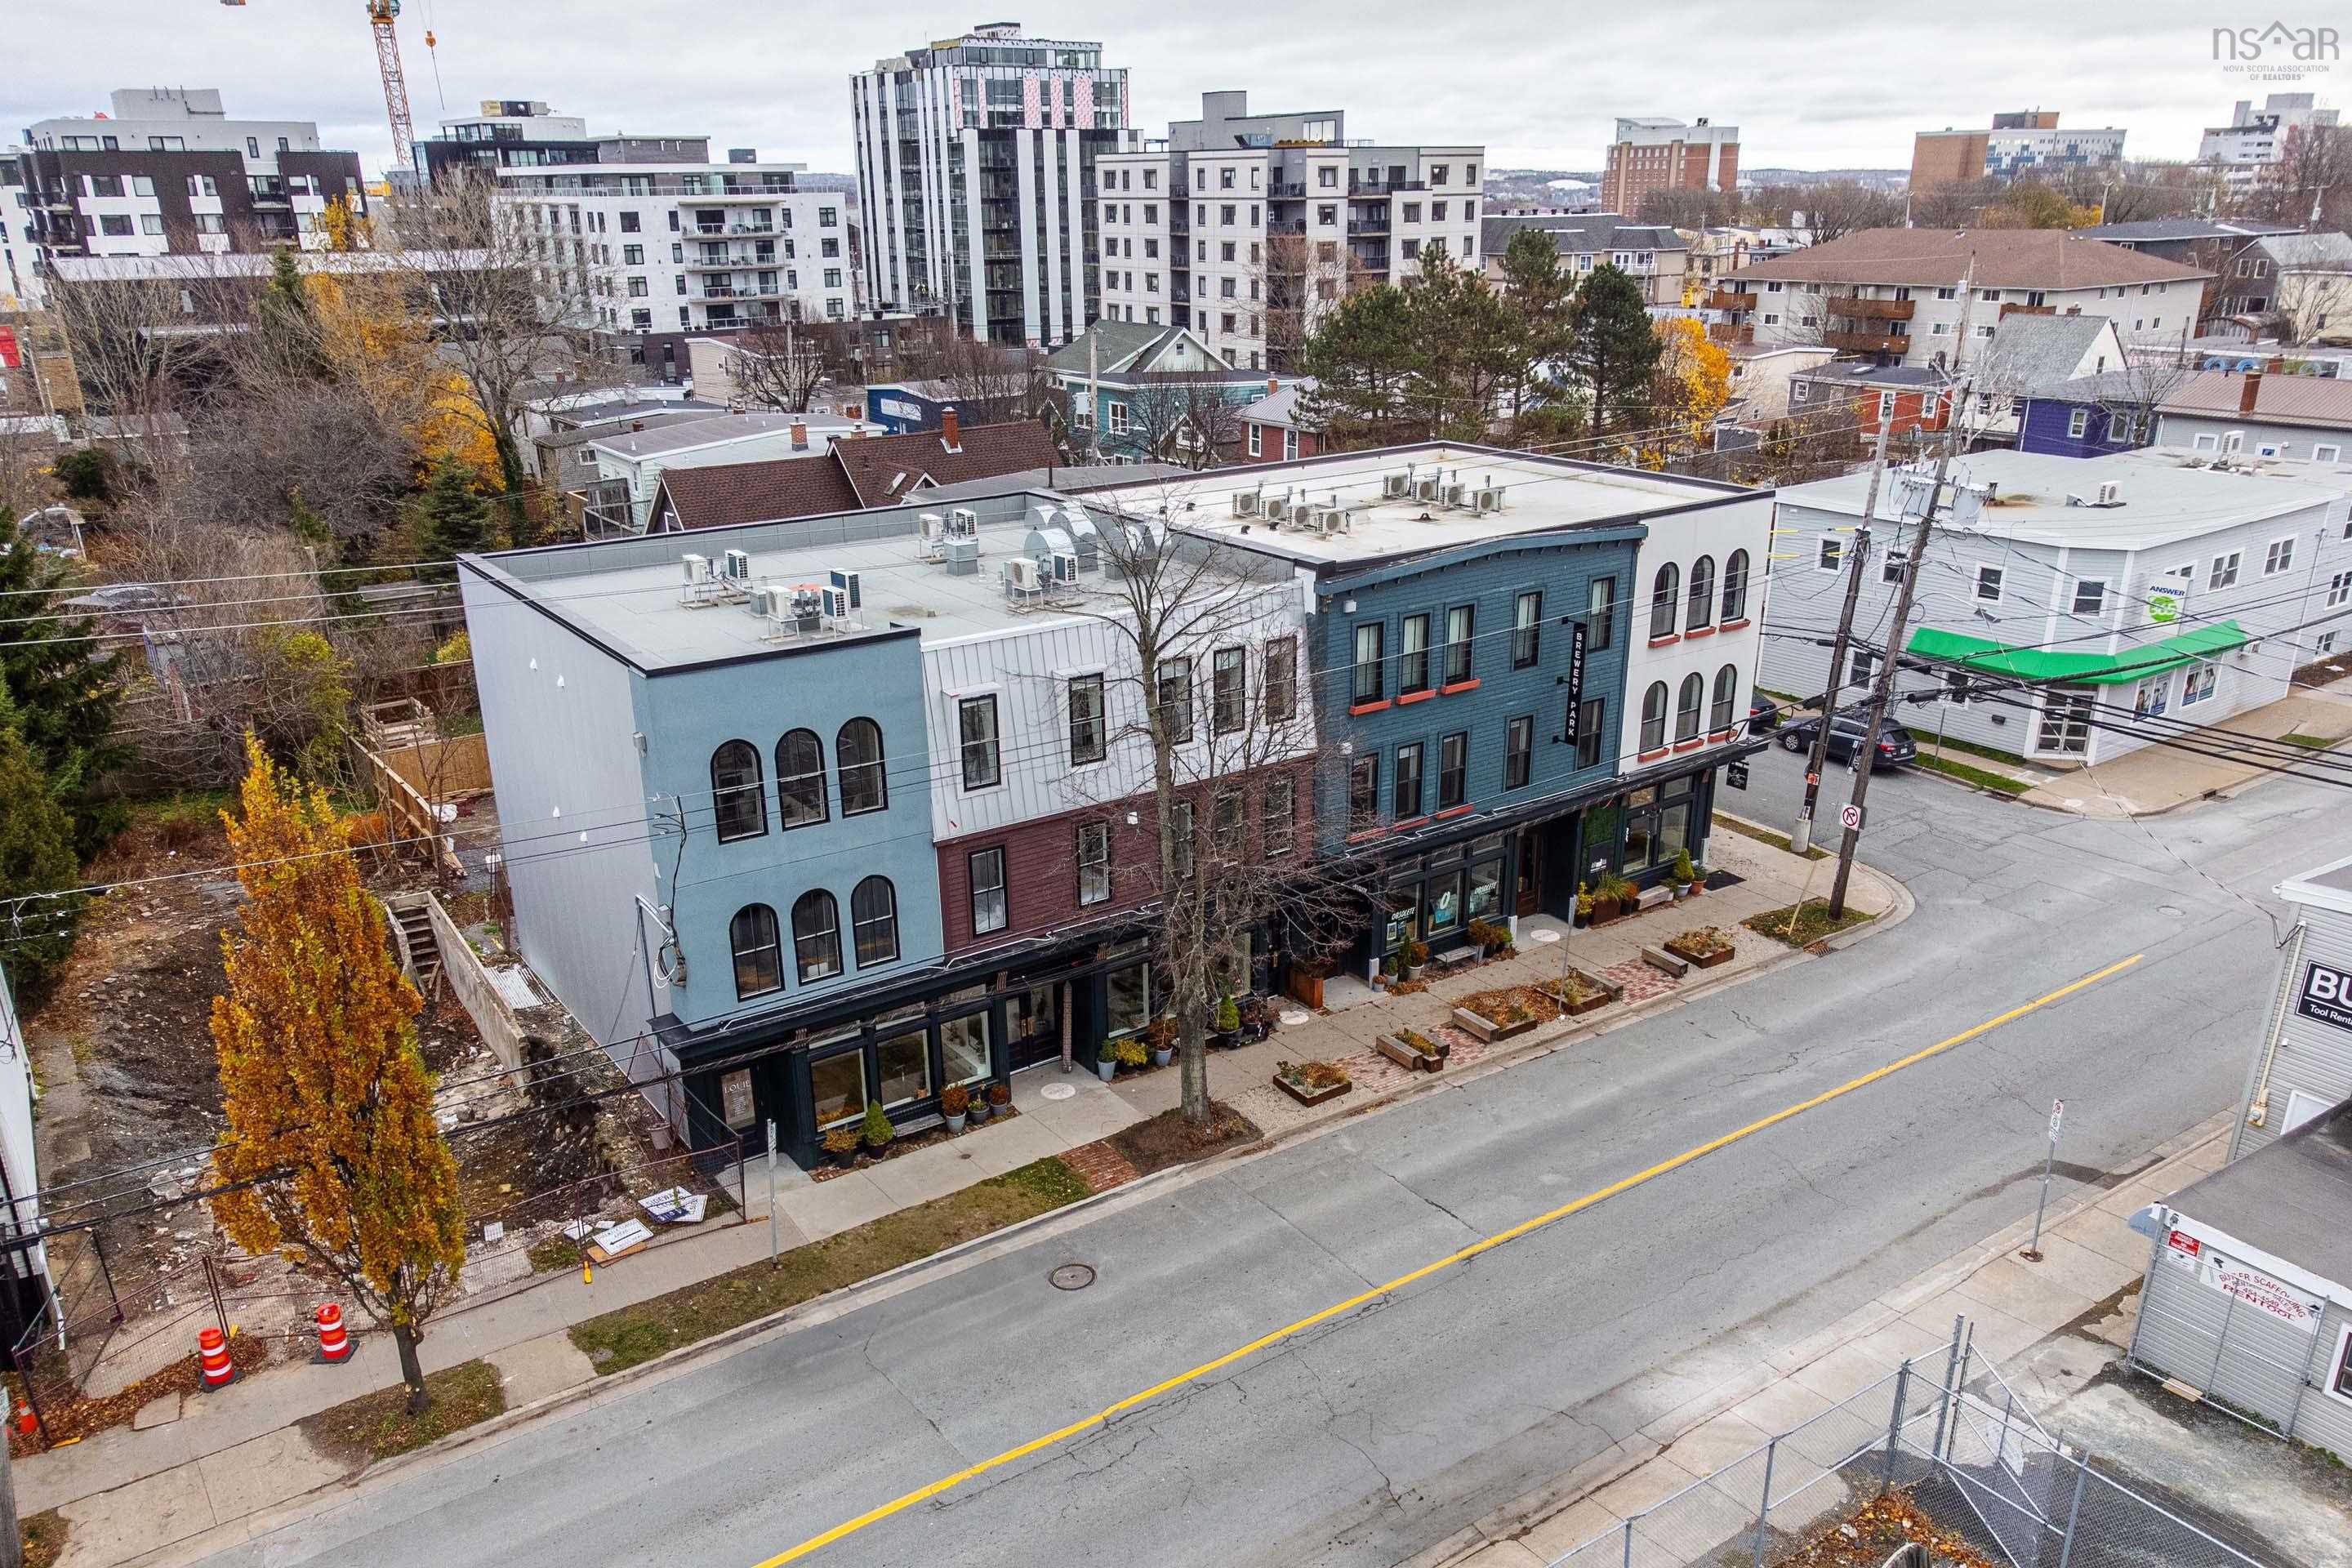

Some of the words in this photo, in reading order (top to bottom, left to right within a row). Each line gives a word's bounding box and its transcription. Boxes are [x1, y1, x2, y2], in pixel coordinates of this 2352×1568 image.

[2149, 586, 2185, 596] ANSWER
[1572, 632, 1583, 694] BREWERY
[1568, 702, 1577, 736] PARK
[1392, 906, 1416, 920] OBSOLETE
[2310, 1004, 2329, 1017] Tool
[2219, 1272, 2251, 1282] BUTER
